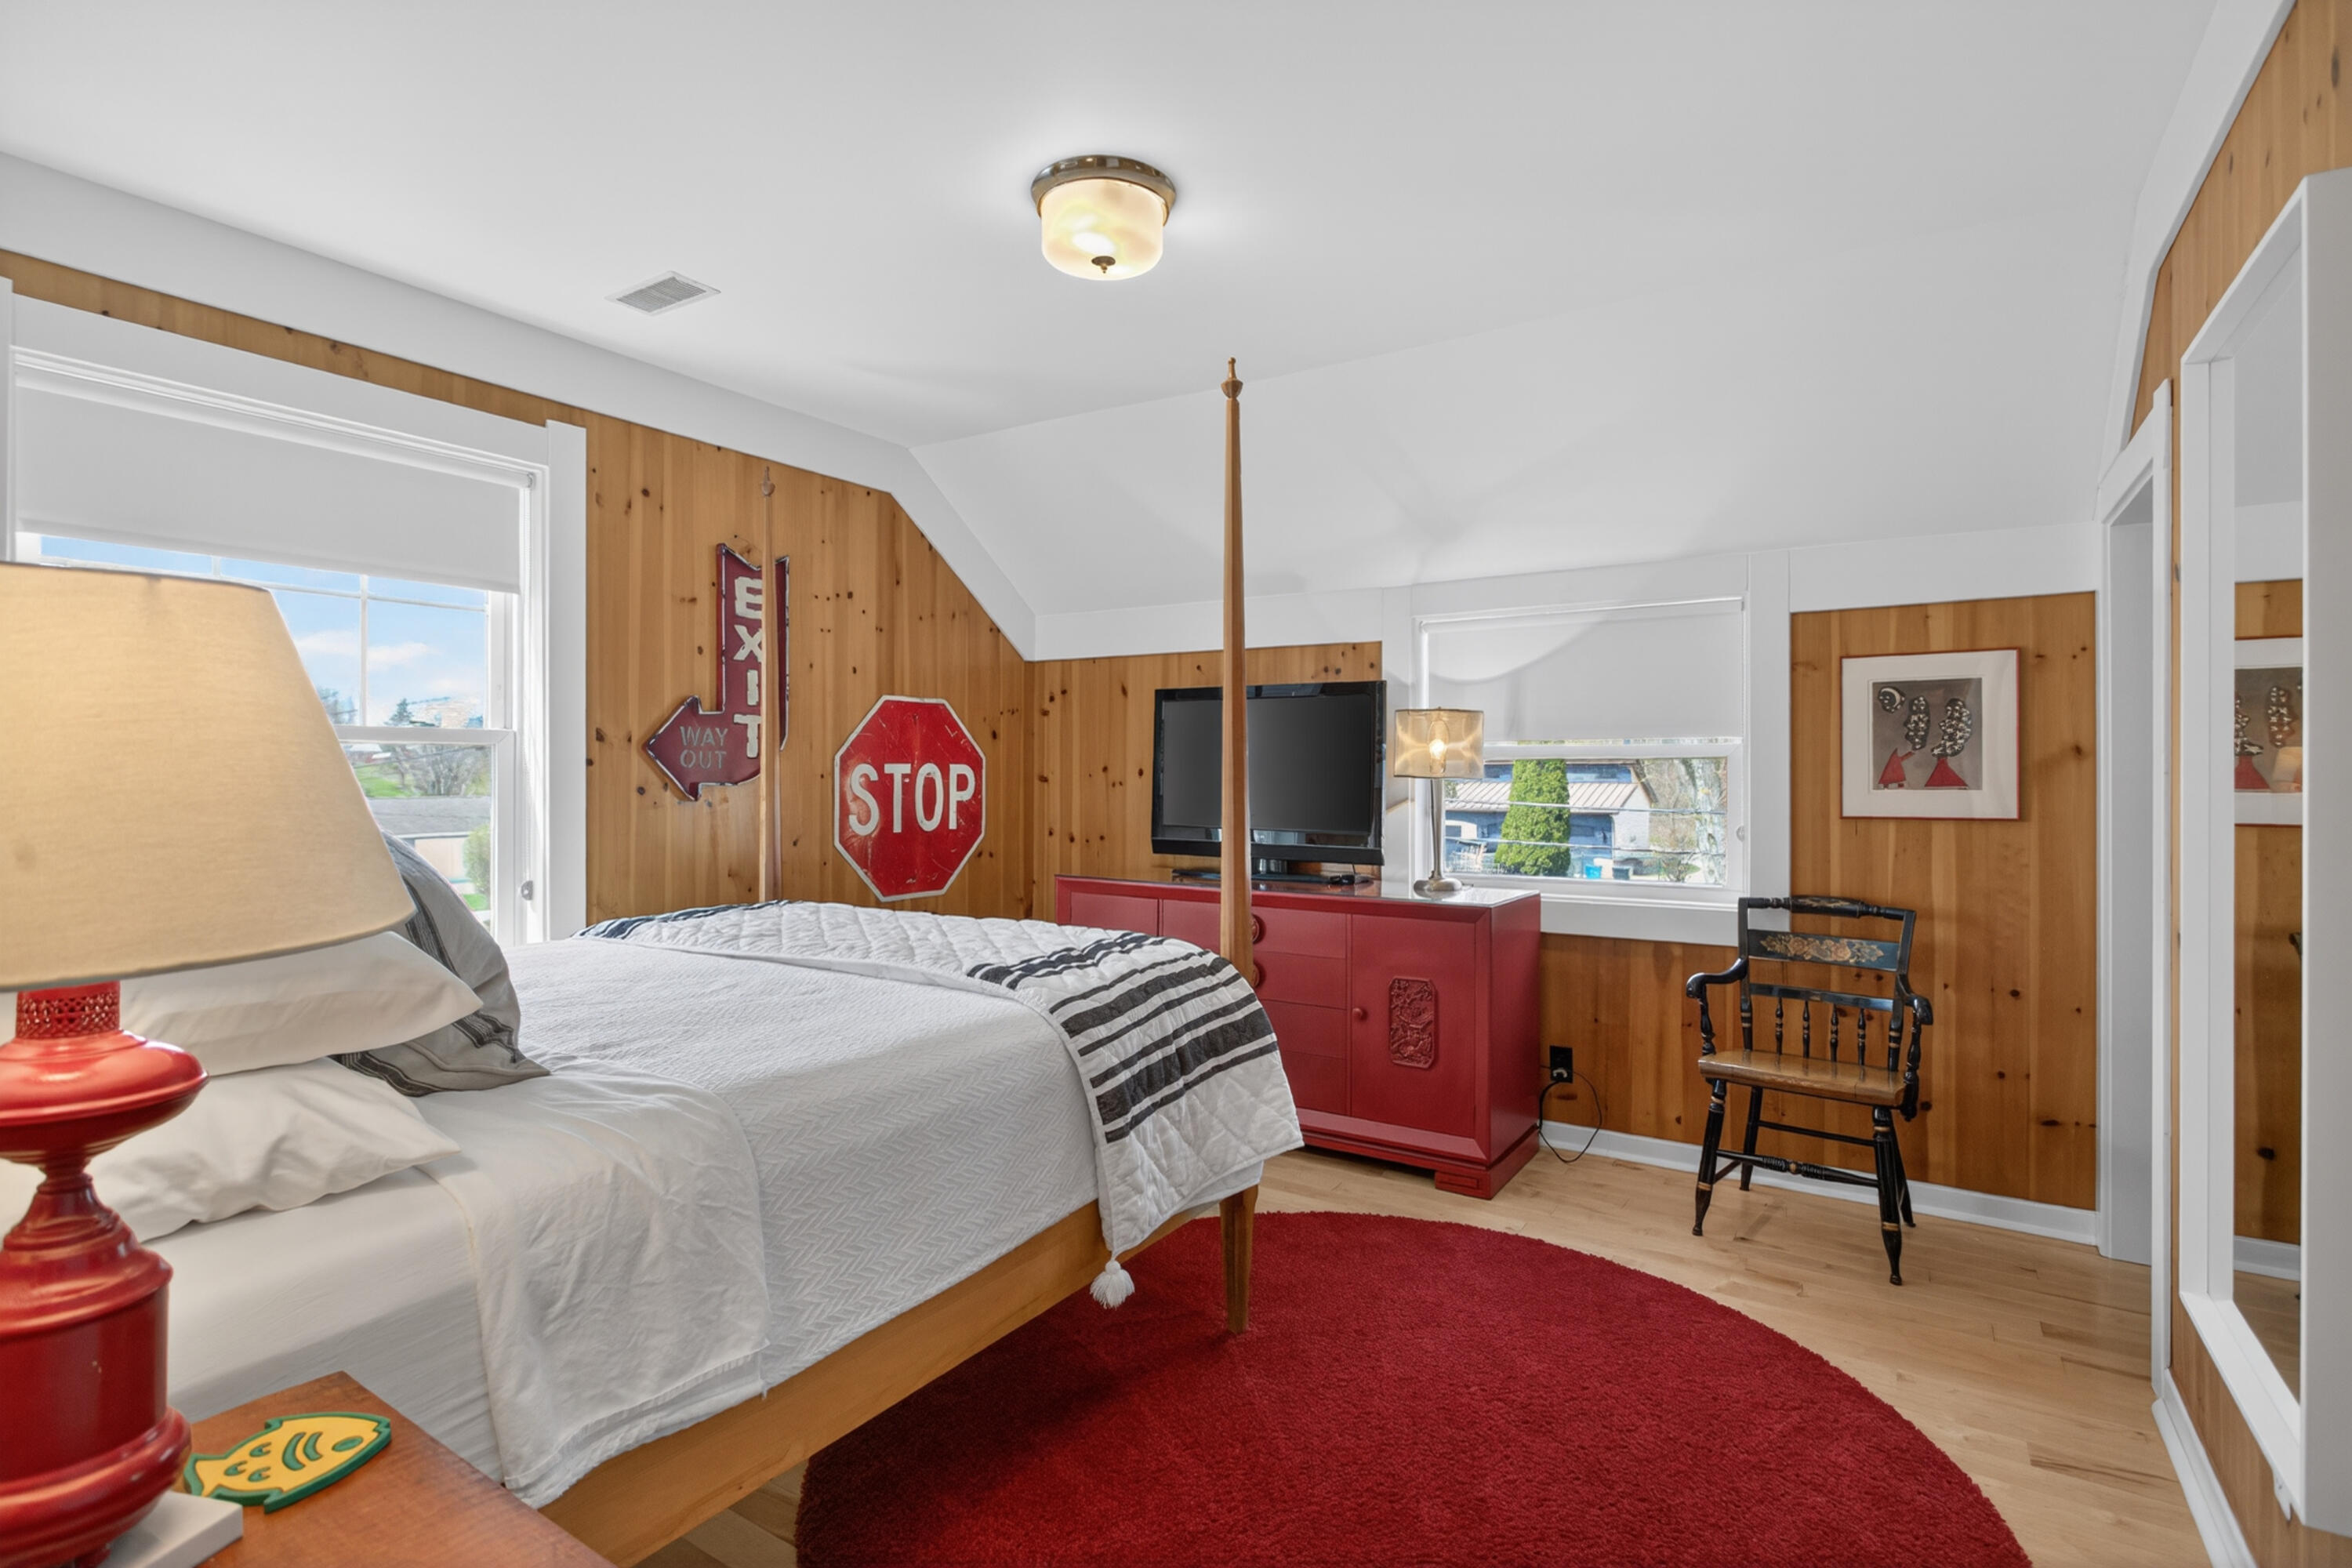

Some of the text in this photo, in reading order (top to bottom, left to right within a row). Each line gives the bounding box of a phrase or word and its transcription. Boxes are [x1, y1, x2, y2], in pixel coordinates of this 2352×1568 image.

[733, 575, 763, 759] EXIT
[679, 725, 728, 746] WAY
[679, 750, 727, 769] OUT
[848, 762, 975, 837] STOP
